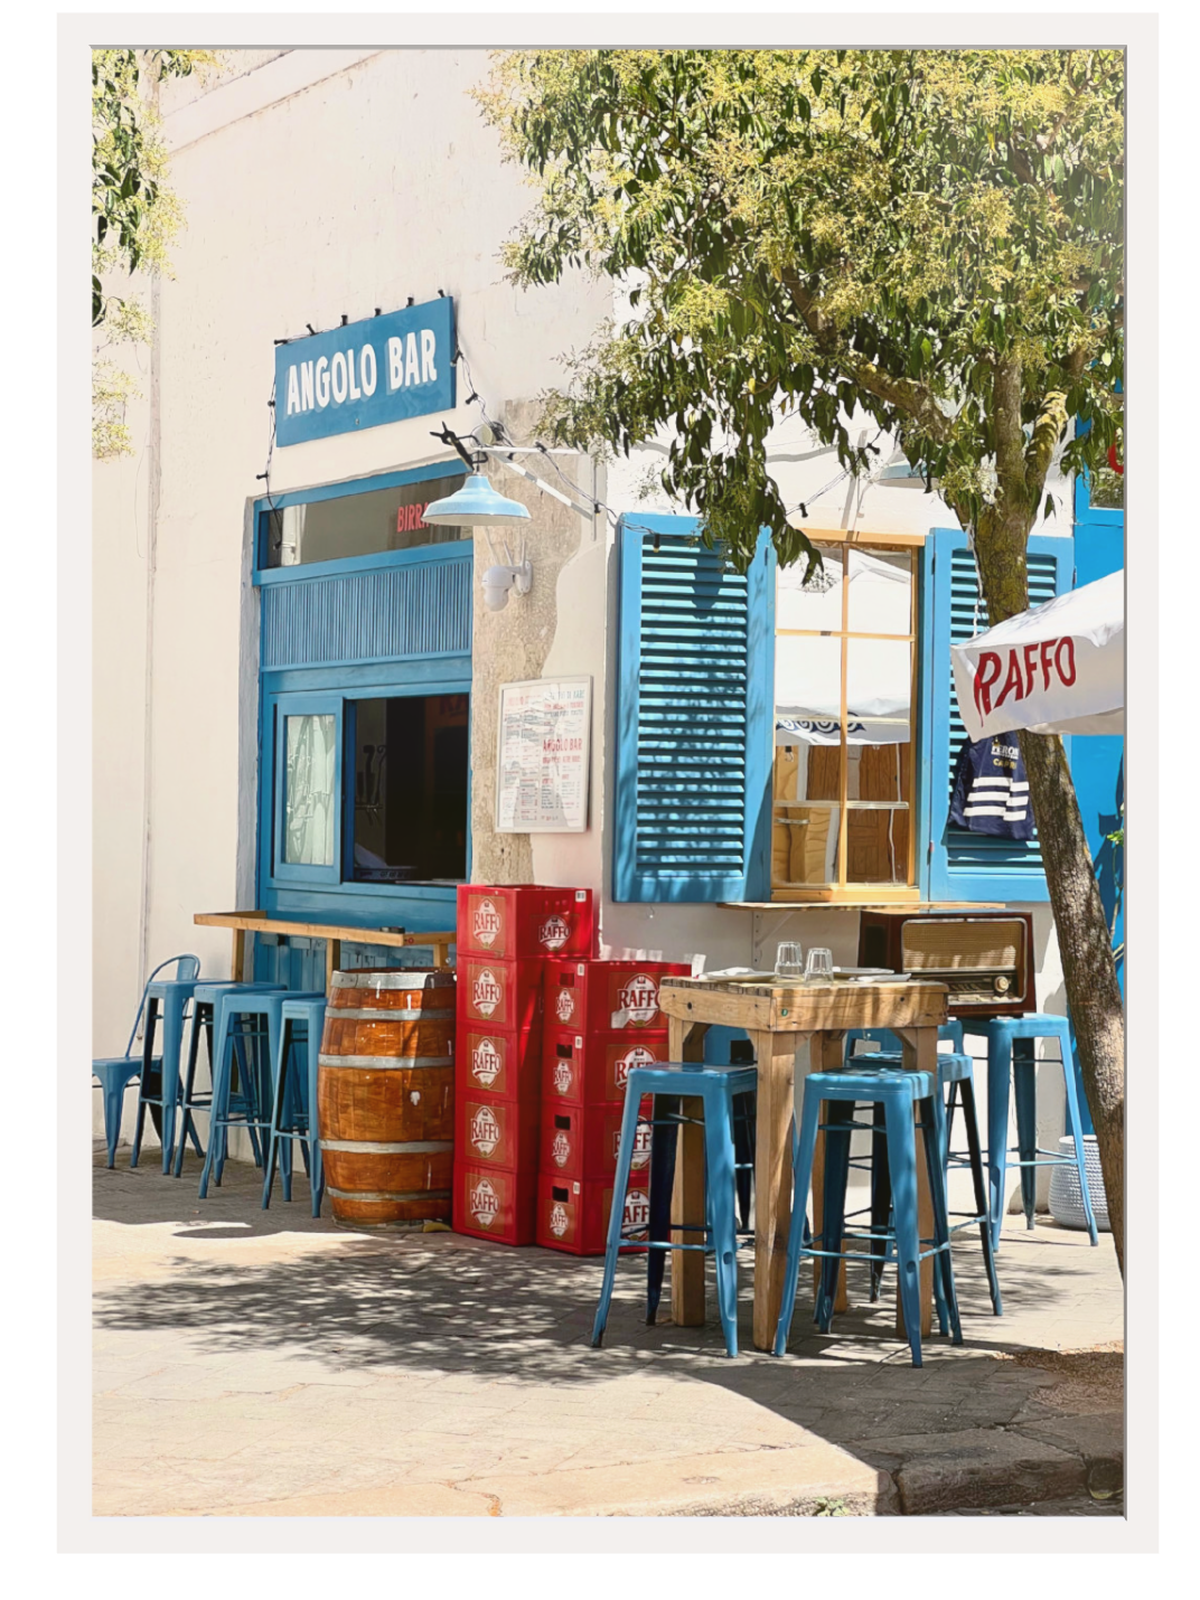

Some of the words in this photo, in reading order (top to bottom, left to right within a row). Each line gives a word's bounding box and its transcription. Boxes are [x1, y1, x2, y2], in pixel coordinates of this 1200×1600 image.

[286, 343, 377, 415] ANGOLO
[388, 329, 437, 390] BAR
[974, 636, 1076, 727] RAFFO
[570, 738, 582, 751] BAR
[474, 911, 500, 931] RAFFO
[540, 925, 570, 940] RAFFO
[473, 981, 500, 1001] RAFFO
[472, 1051, 500, 1070] RAFFO
[471, 1119, 499, 1139] RAFFO
[471, 1191, 499, 1212] RAFFO
[624, 1205, 649, 1222] AFF
